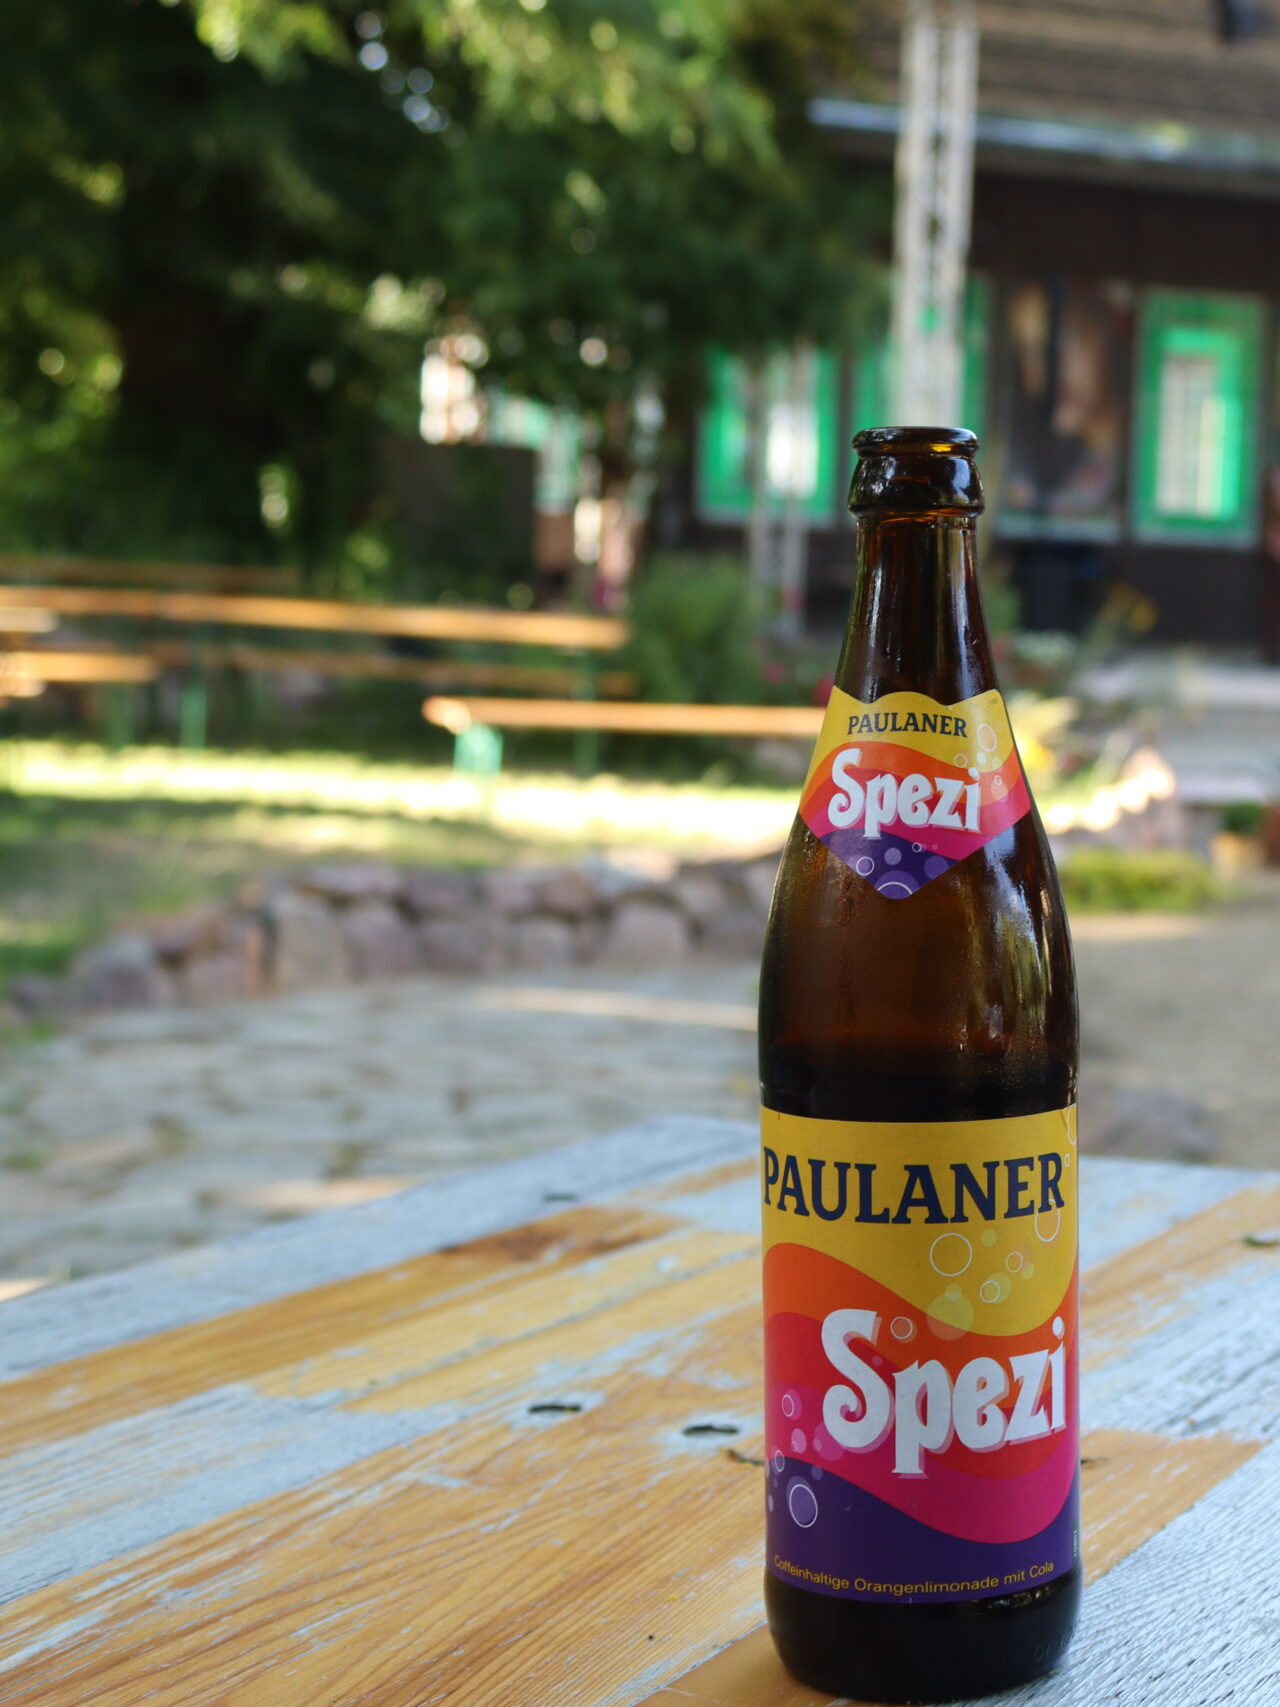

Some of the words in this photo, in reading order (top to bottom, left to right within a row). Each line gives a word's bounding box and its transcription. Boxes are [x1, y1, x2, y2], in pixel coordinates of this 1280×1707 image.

[847, 712, 968, 738] PAULANER
[827, 747, 981, 839] Spezi
[763, 1146, 1065, 1224] PAULANER
[821, 1308, 1067, 1475] Spezi
[774, 1554, 850, 1590] Coffeinhaltige
[854, 1576, 999, 1596] Orangenlimonade
[1004, 1570, 1026, 1585] mit
[1029, 1561, 1055, 1578] Cola
